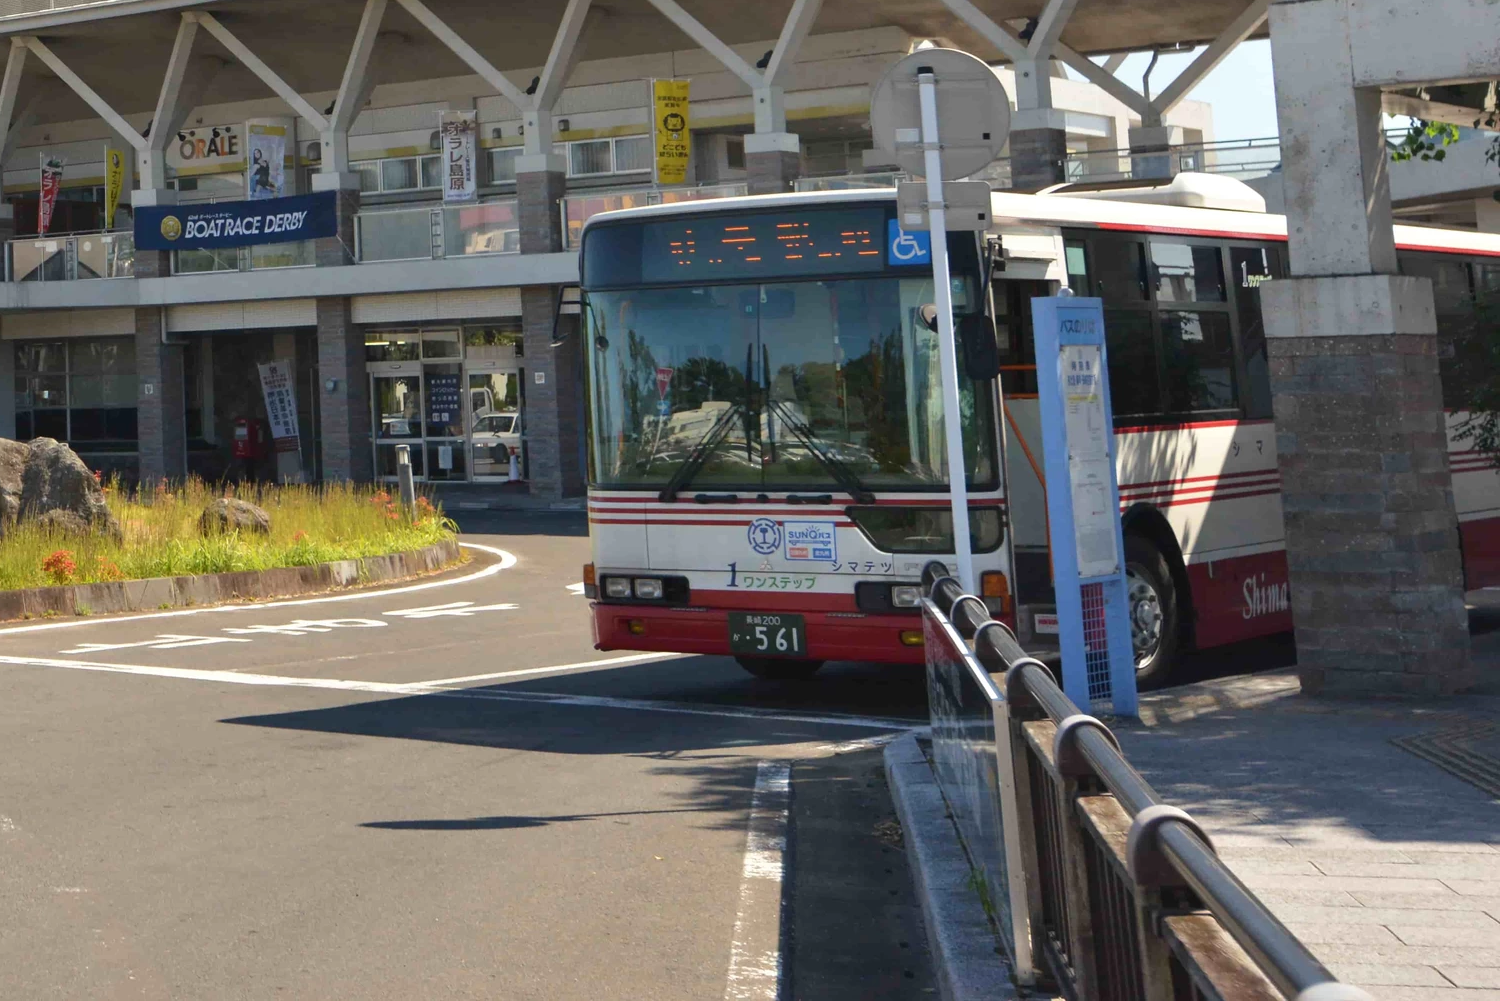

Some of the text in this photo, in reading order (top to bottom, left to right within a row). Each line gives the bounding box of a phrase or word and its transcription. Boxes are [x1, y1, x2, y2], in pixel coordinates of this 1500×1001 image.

[180, 135, 238, 160] ORALE
[264, 211, 307, 233] DERBY
[832, 561, 892, 573] シマテツ
[743, 576, 816, 590] ワンステップ
